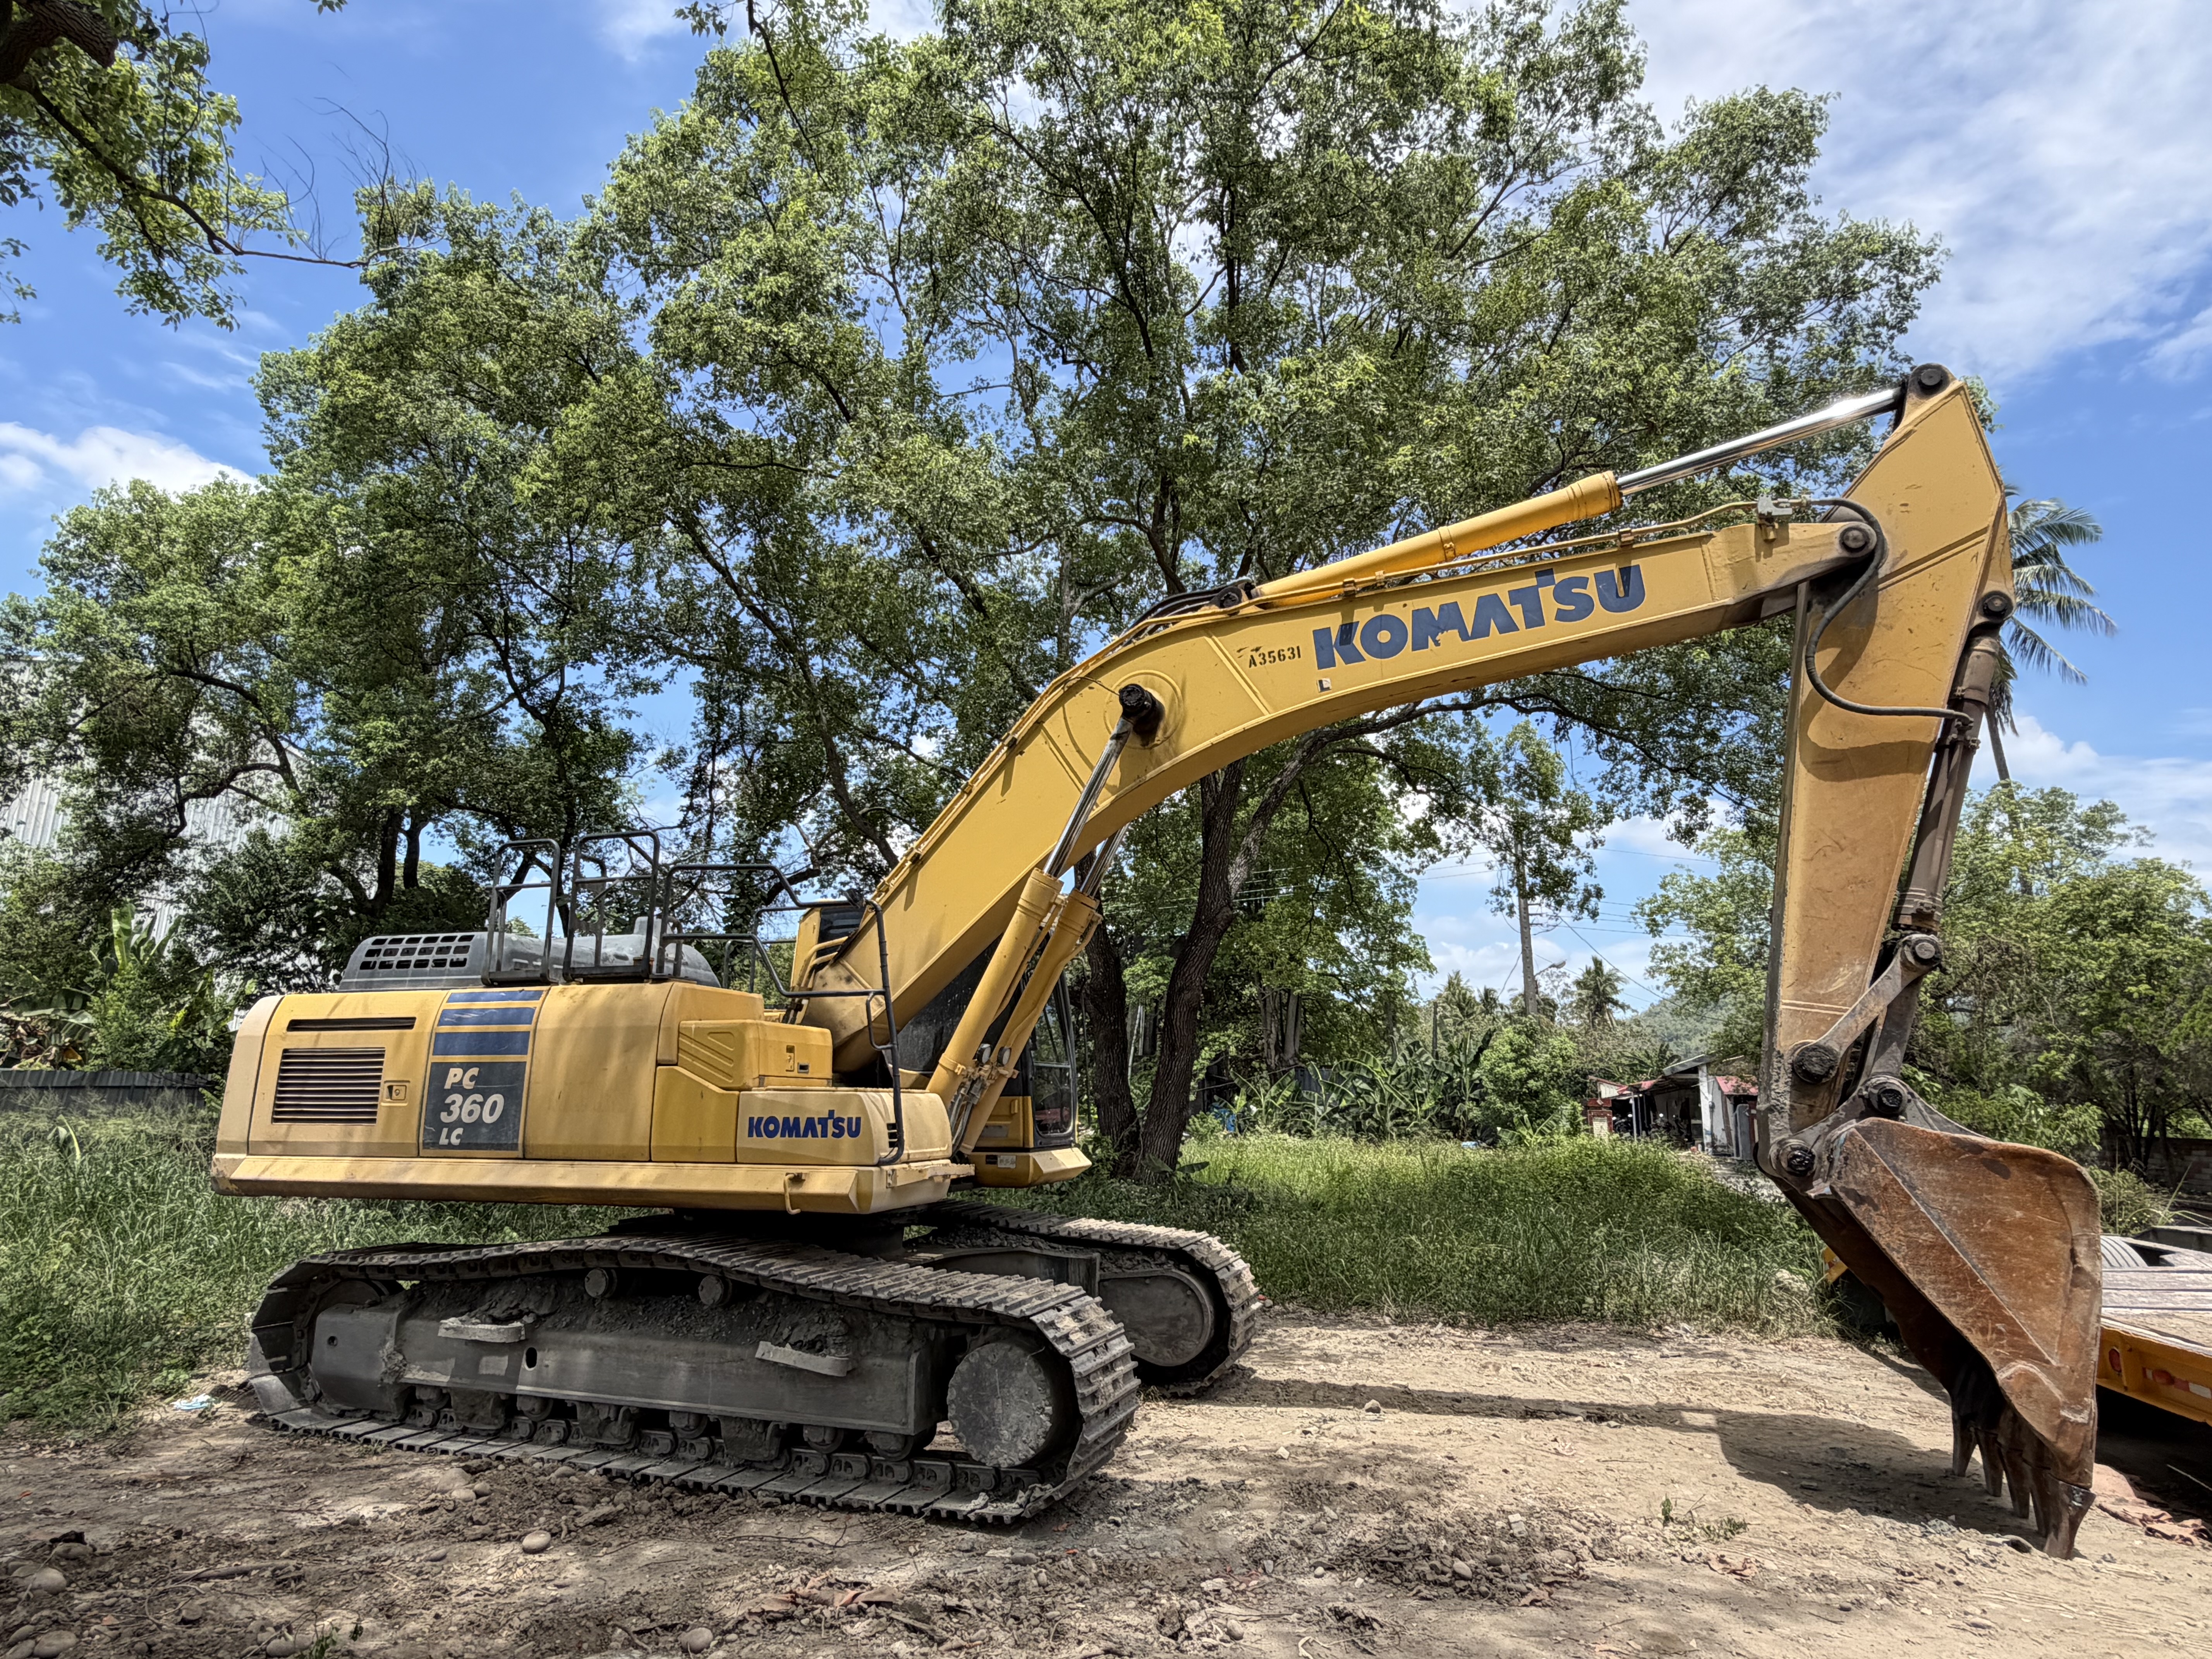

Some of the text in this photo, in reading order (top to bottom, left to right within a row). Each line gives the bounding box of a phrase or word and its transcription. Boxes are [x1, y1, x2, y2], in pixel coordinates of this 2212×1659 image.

[1312, 564, 1645, 670] KOMATSU
[1249, 646, 1301, 668] A35631
[444, 1067, 479, 1089] PC
[440, 1094, 505, 1123] 360
[748, 1109, 861, 1138] KOMATSU
[439, 1128, 464, 1146] LC
